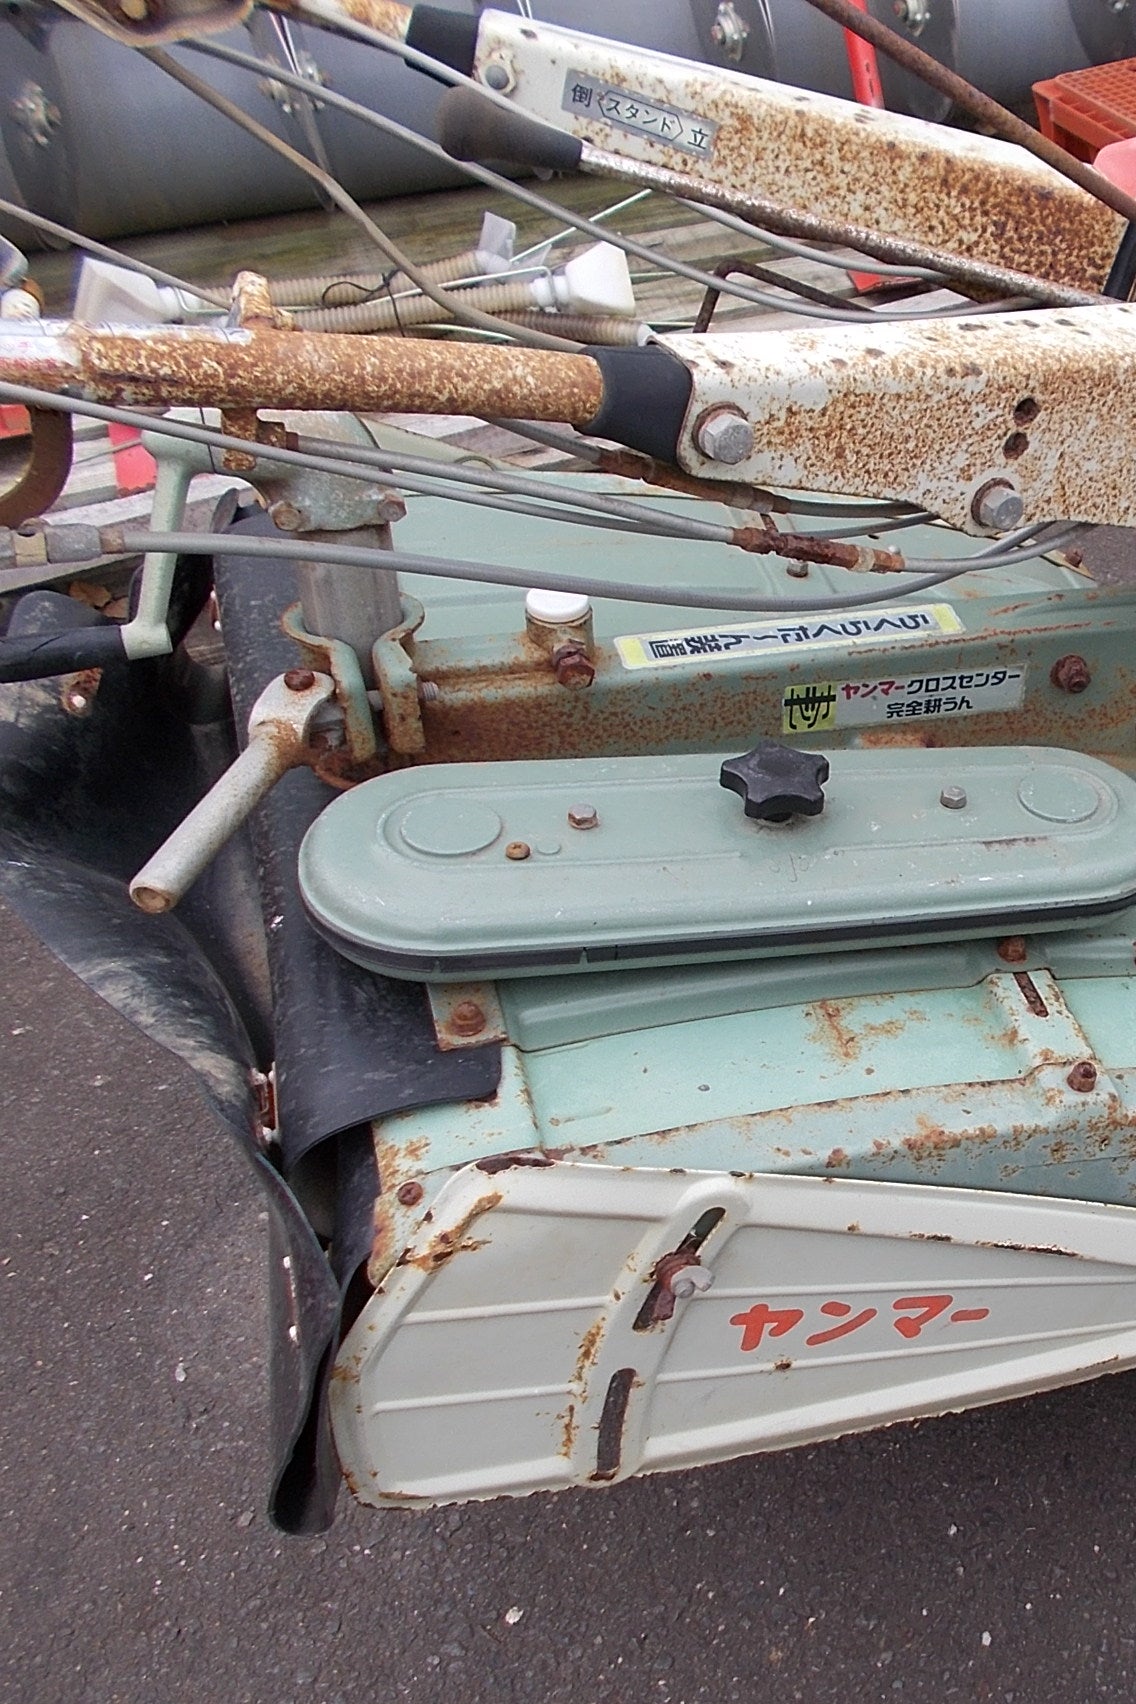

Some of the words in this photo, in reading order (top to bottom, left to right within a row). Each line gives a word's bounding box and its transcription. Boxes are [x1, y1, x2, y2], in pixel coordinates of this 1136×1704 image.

[571, 83, 593, 108] 倒
[606, 98, 676, 133] スタンド
[687, 128, 709, 150] 立
[840, 670, 1021, 700] ヤンマークロスセンター
[886, 697, 974, 719] 完全耕うん
[729, 1294, 990, 1351] ヤンマー
